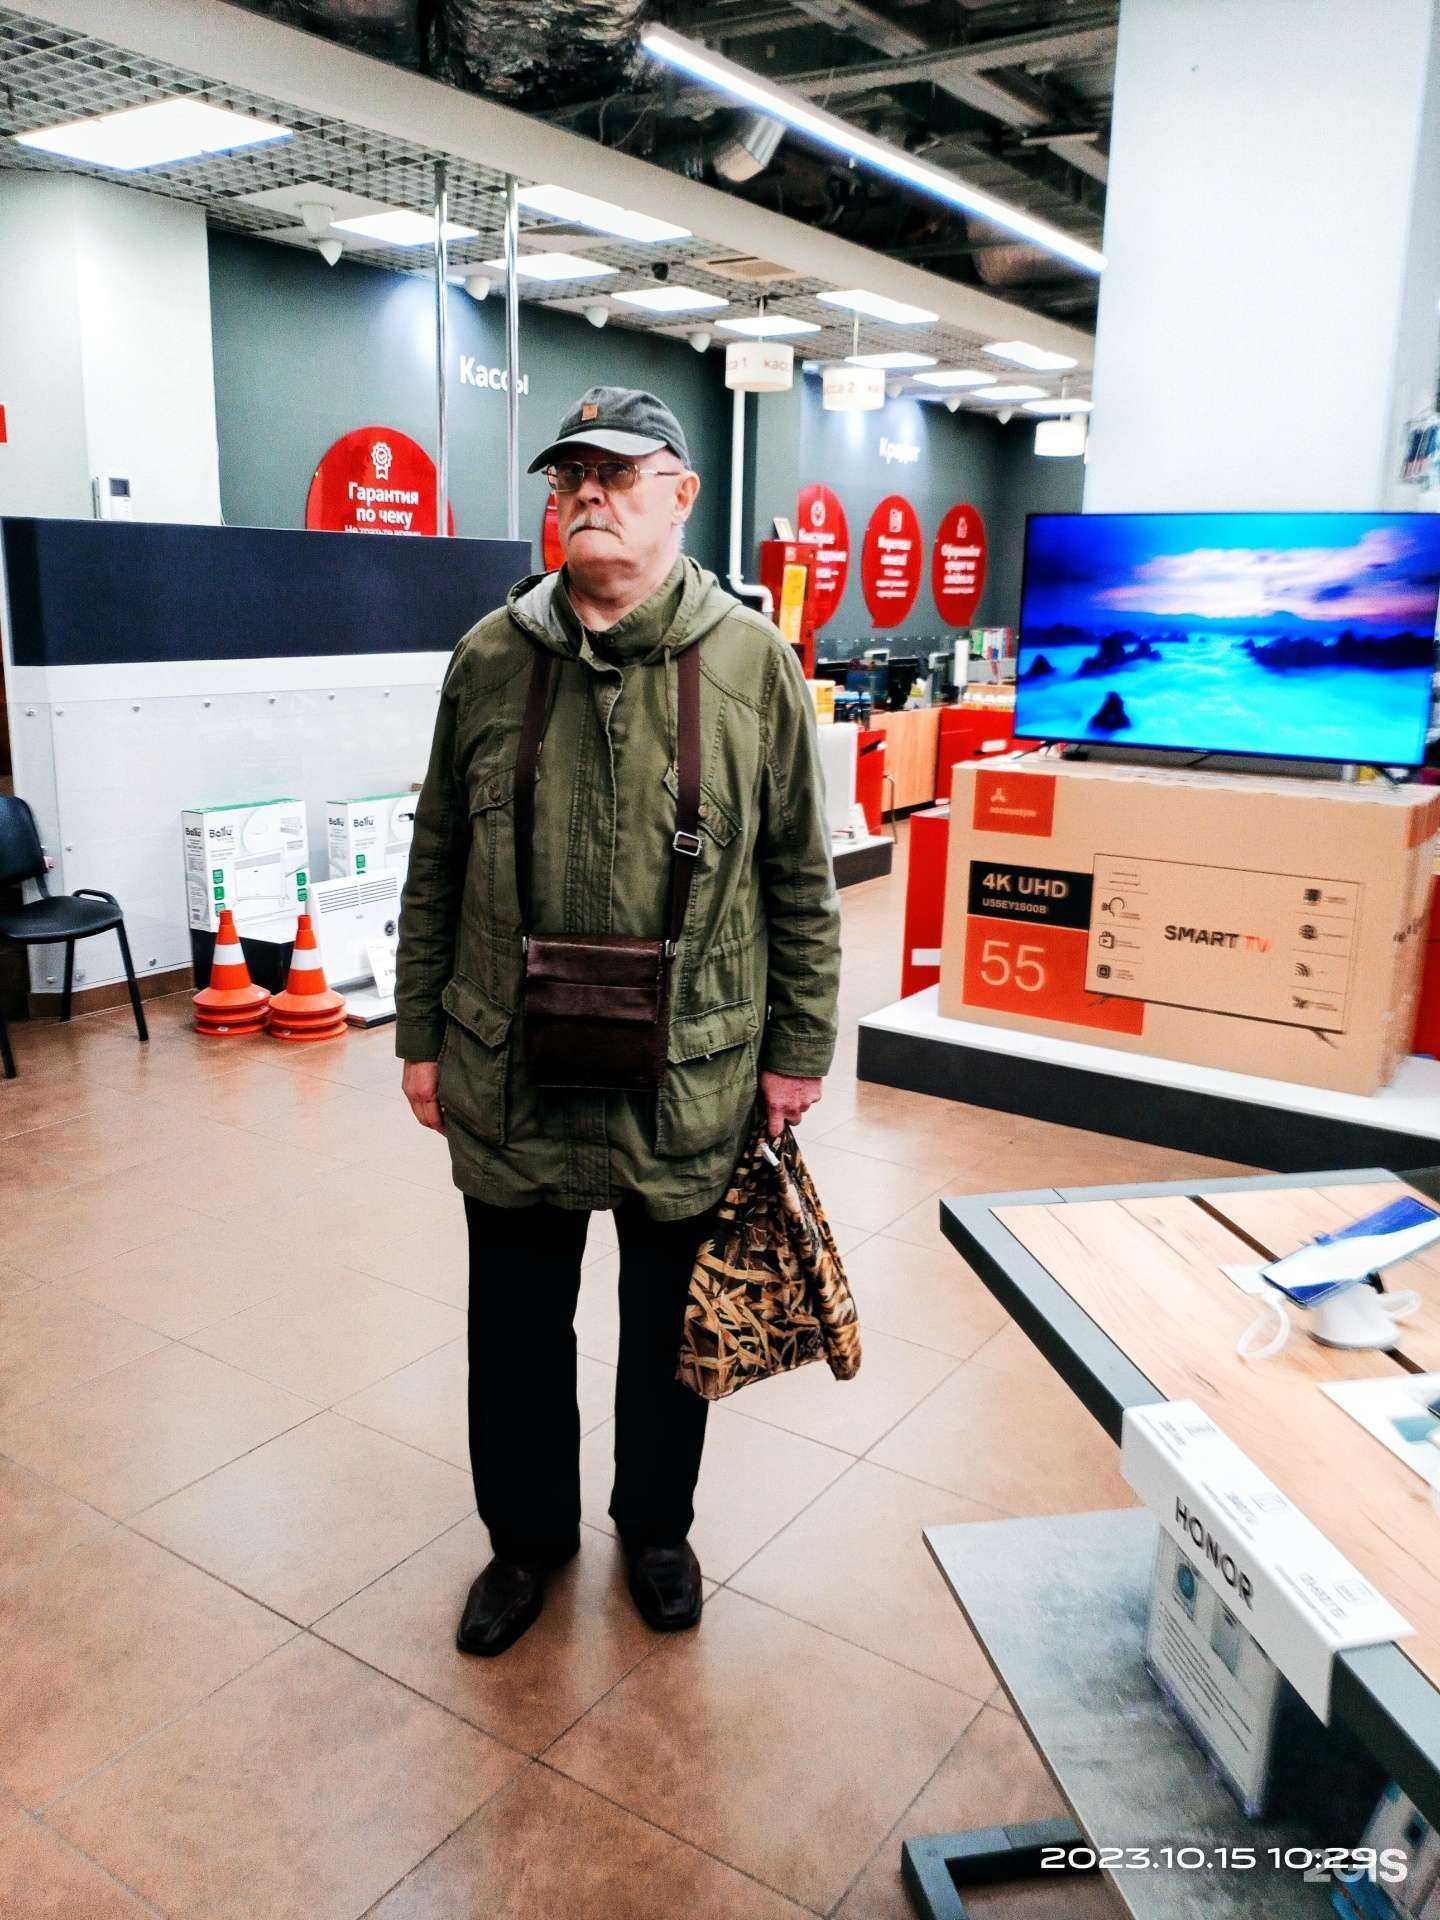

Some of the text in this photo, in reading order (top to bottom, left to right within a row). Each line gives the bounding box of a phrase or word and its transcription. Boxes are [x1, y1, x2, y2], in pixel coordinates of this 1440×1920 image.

[348, 481, 419, 506] Гарантия
[356, 507, 413, 530] по чеку
[982, 872, 1069, 898] 4K UHD
[1164, 925, 1240, 949] SMART
[1243, 934, 1272, 953] TV
[980, 939, 1046, 993] 55
[1175, 1496, 1254, 1613] HONOR
